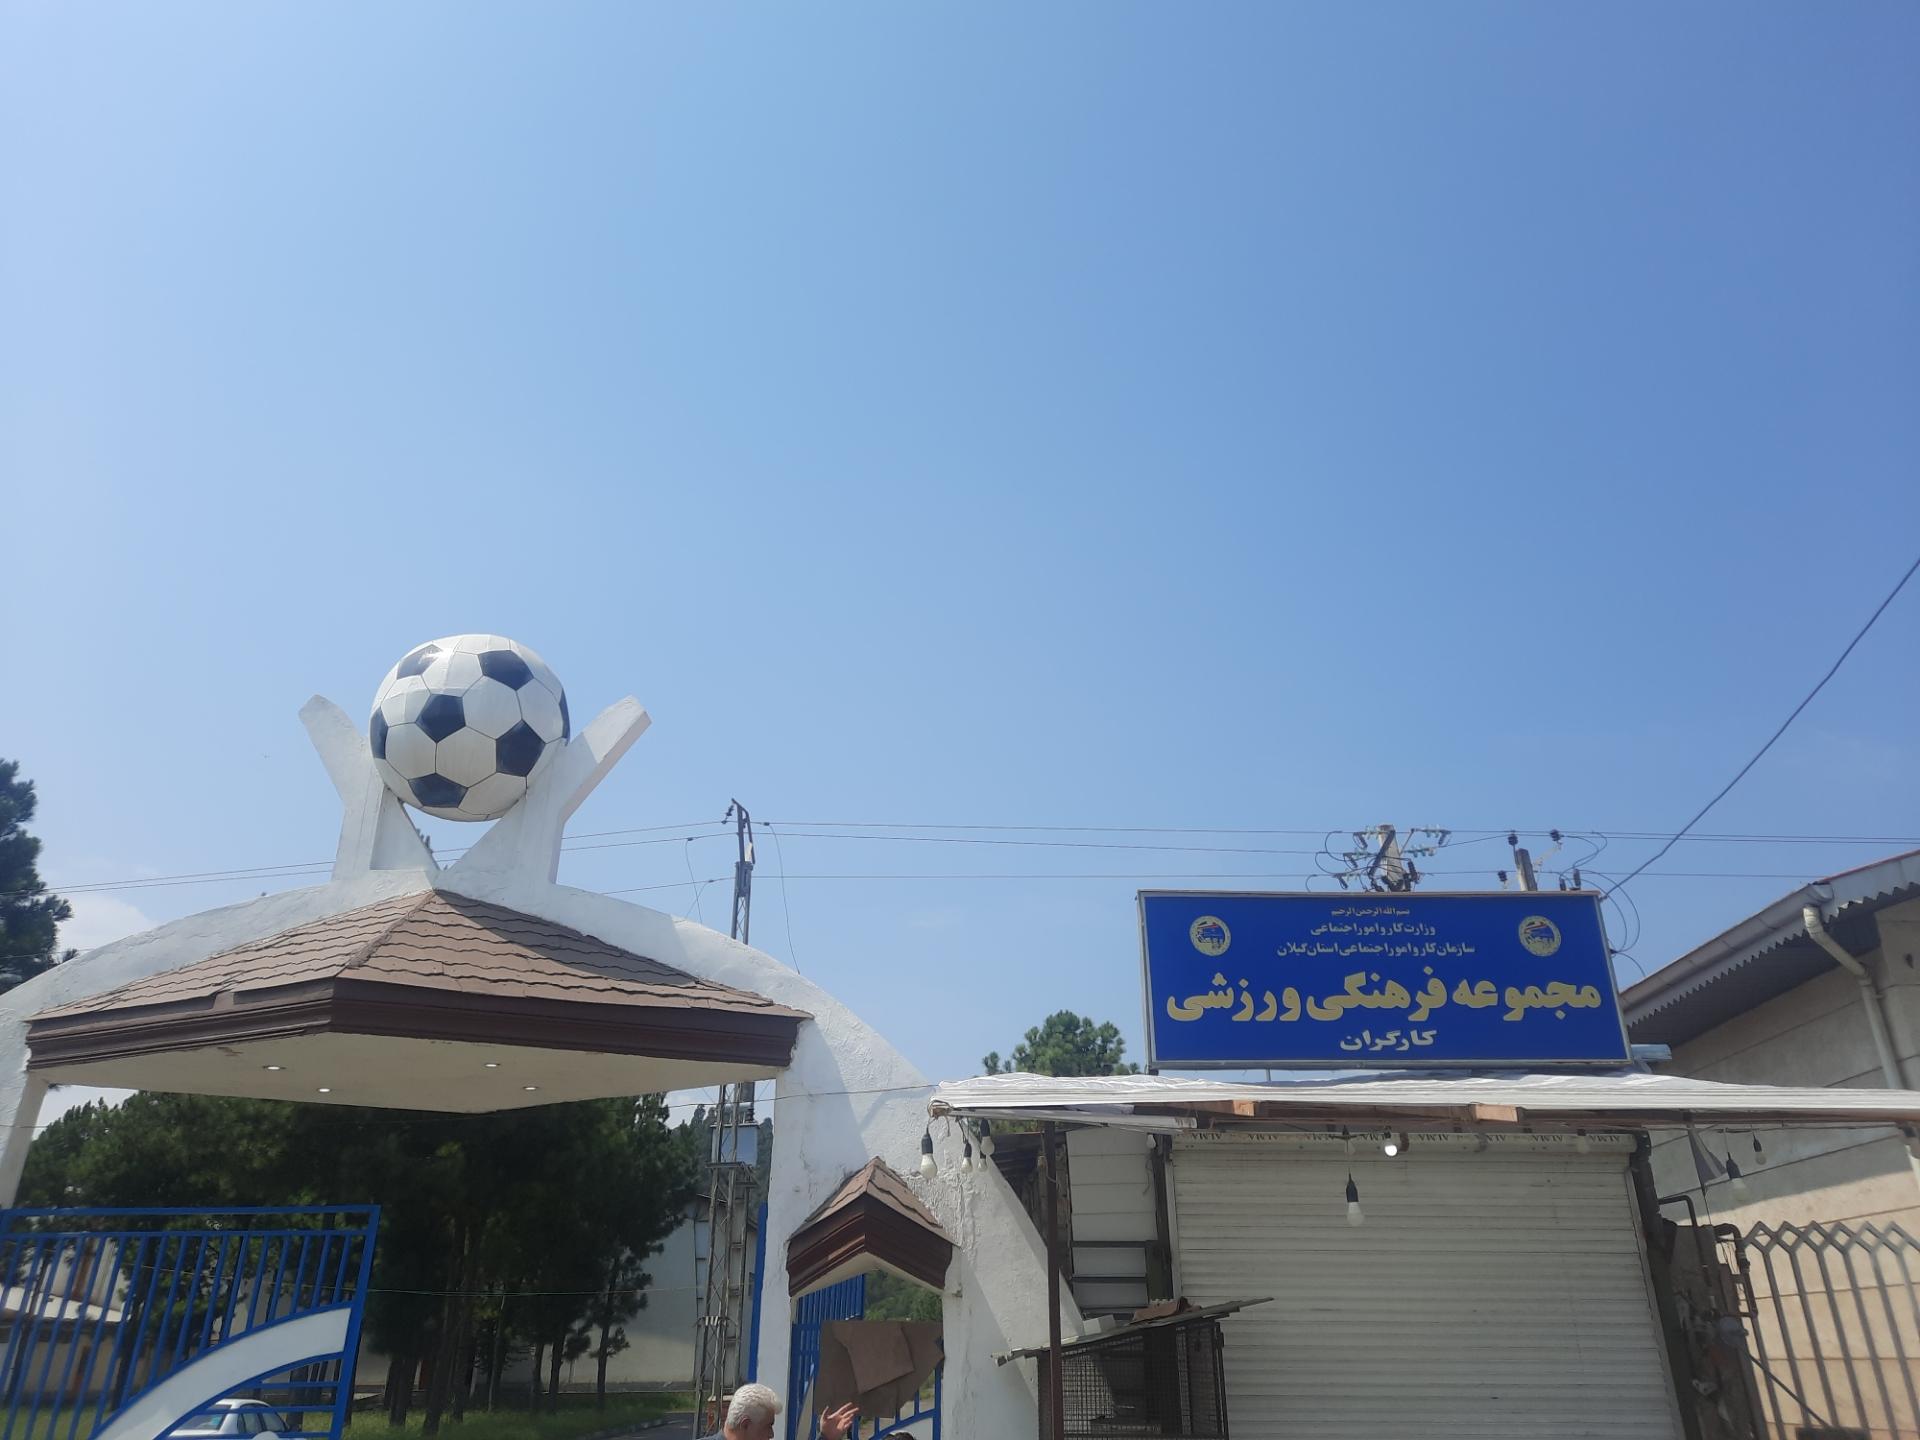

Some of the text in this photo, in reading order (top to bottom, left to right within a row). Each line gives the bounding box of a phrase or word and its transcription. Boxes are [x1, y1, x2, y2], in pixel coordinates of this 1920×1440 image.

[1311, 922, 1436, 936] وزارت کار و امور اجتماعی
[1307, 942, 1339, 957] استان
[1339, 942, 1388, 957] اجتماعی
[1388, 942, 1412, 957] امور
[1412, 947, 1420, 957] و
[1420, 942, 1436, 957] کار
[1437, 942, 1475, 957] سازمان
[1166, 966, 1601, 1023] مجموعه فرهنگی ورزشی
[1340, 1029, 1437, 1051] کارگران
